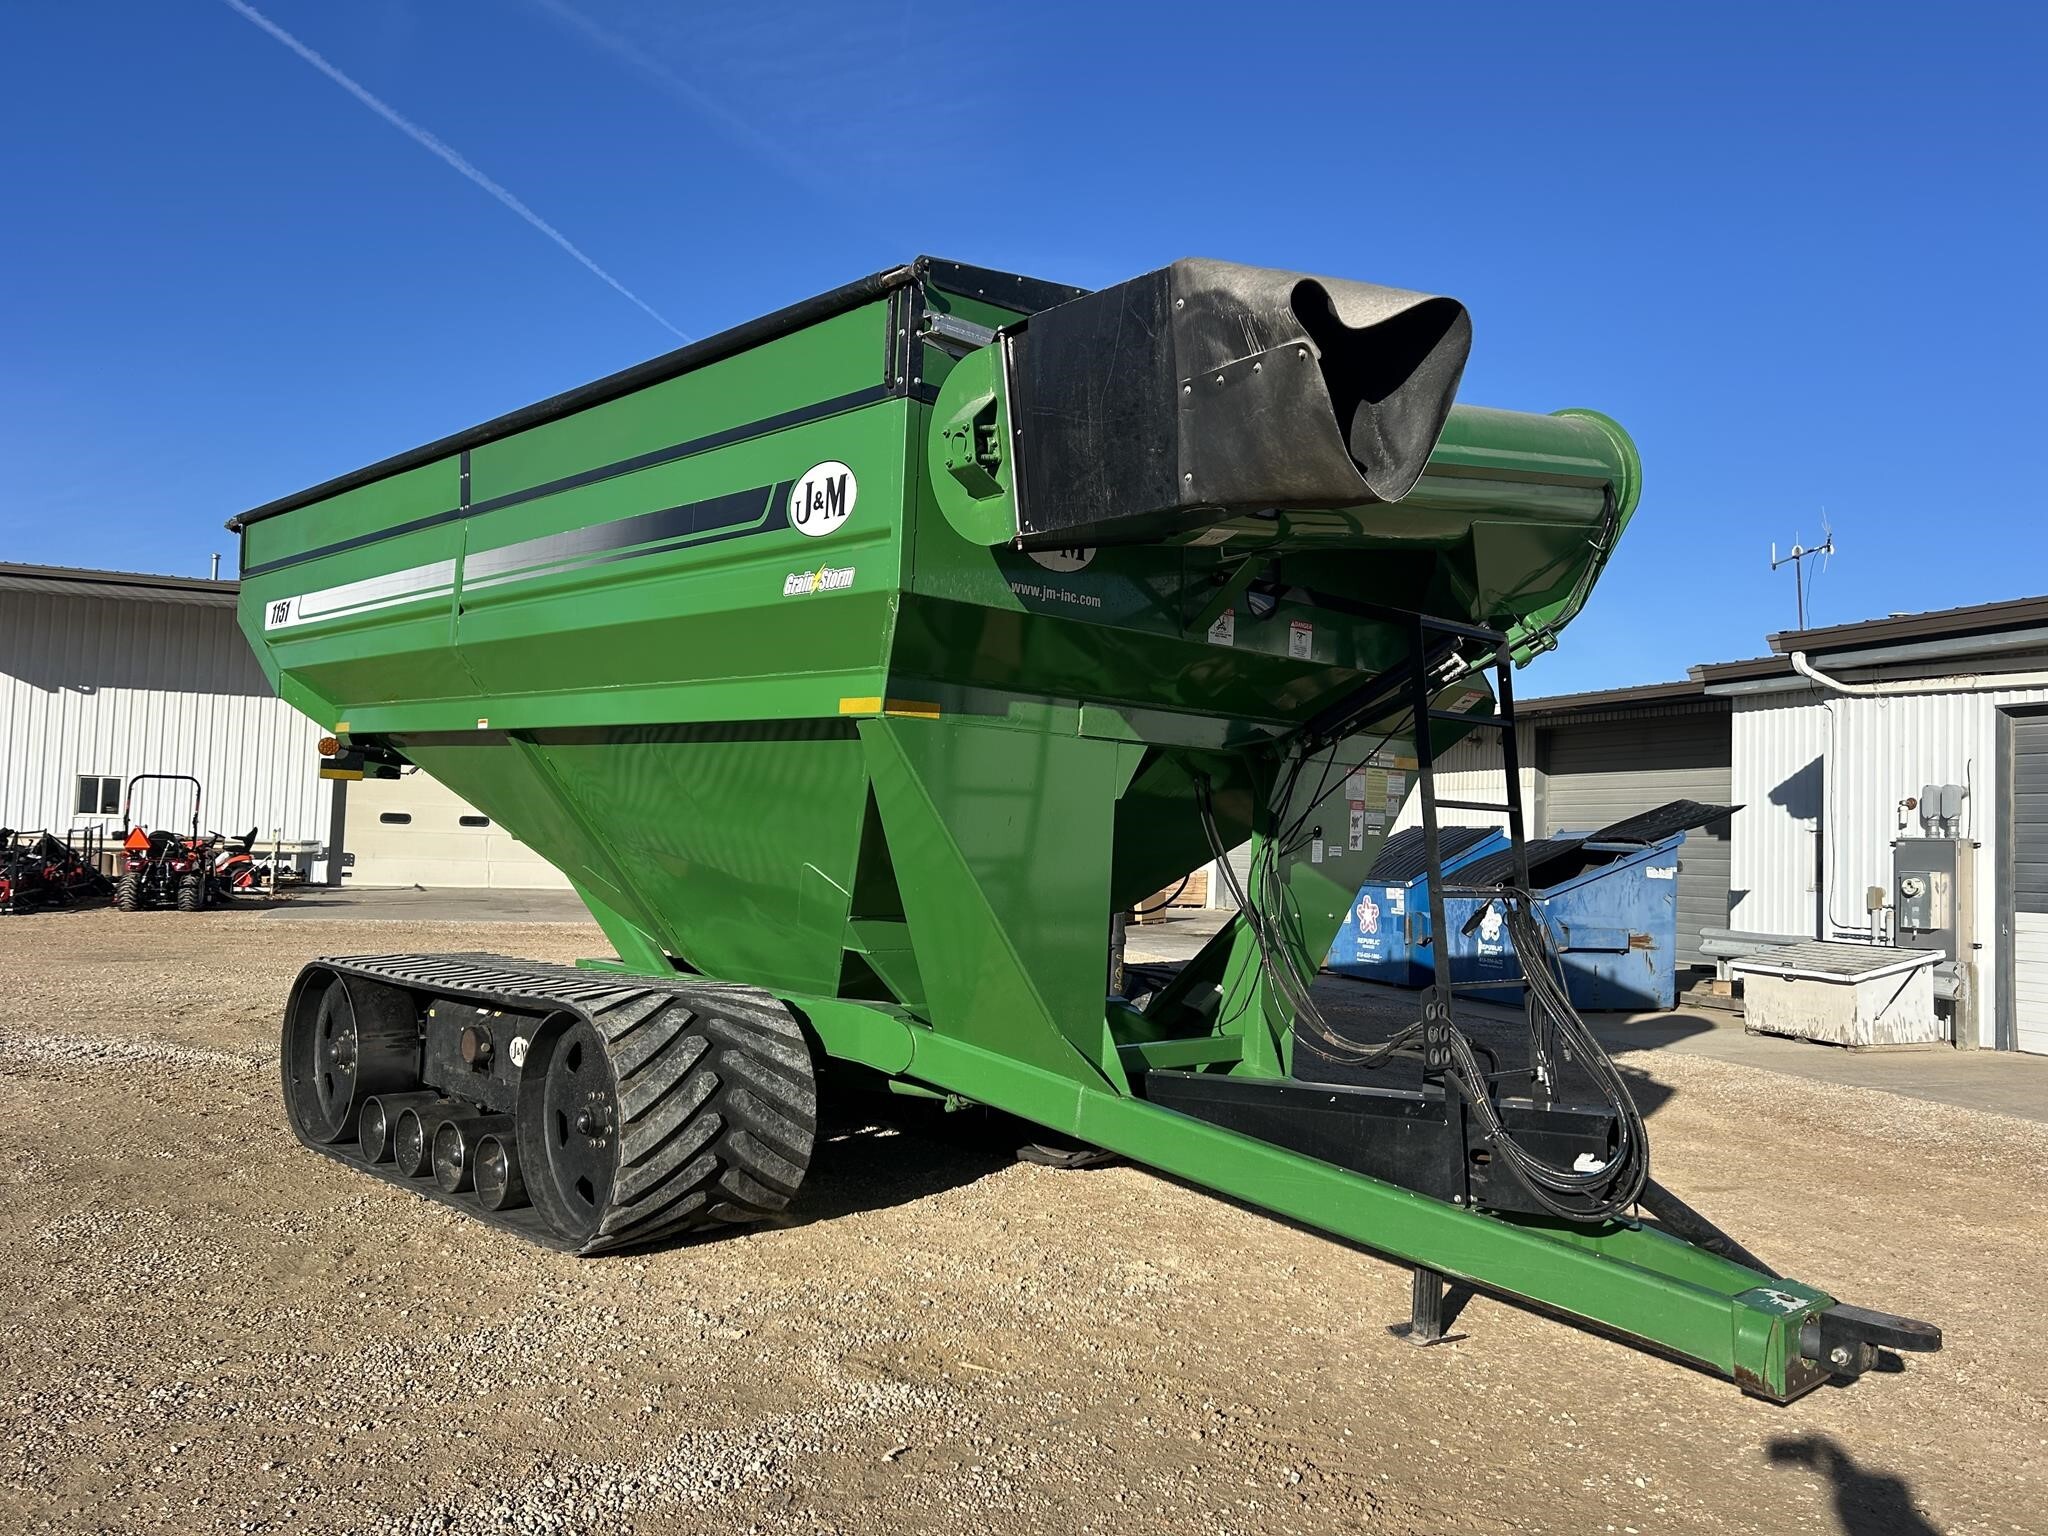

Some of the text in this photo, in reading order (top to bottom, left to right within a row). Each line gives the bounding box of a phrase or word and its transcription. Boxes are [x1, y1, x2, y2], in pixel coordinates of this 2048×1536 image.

[795, 473, 848, 525] J&M
[783, 566, 855, 597] Grain Storm
[1010, 582, 1101, 608] www.jm-inc.com
[270, 600, 292, 625] 1151
